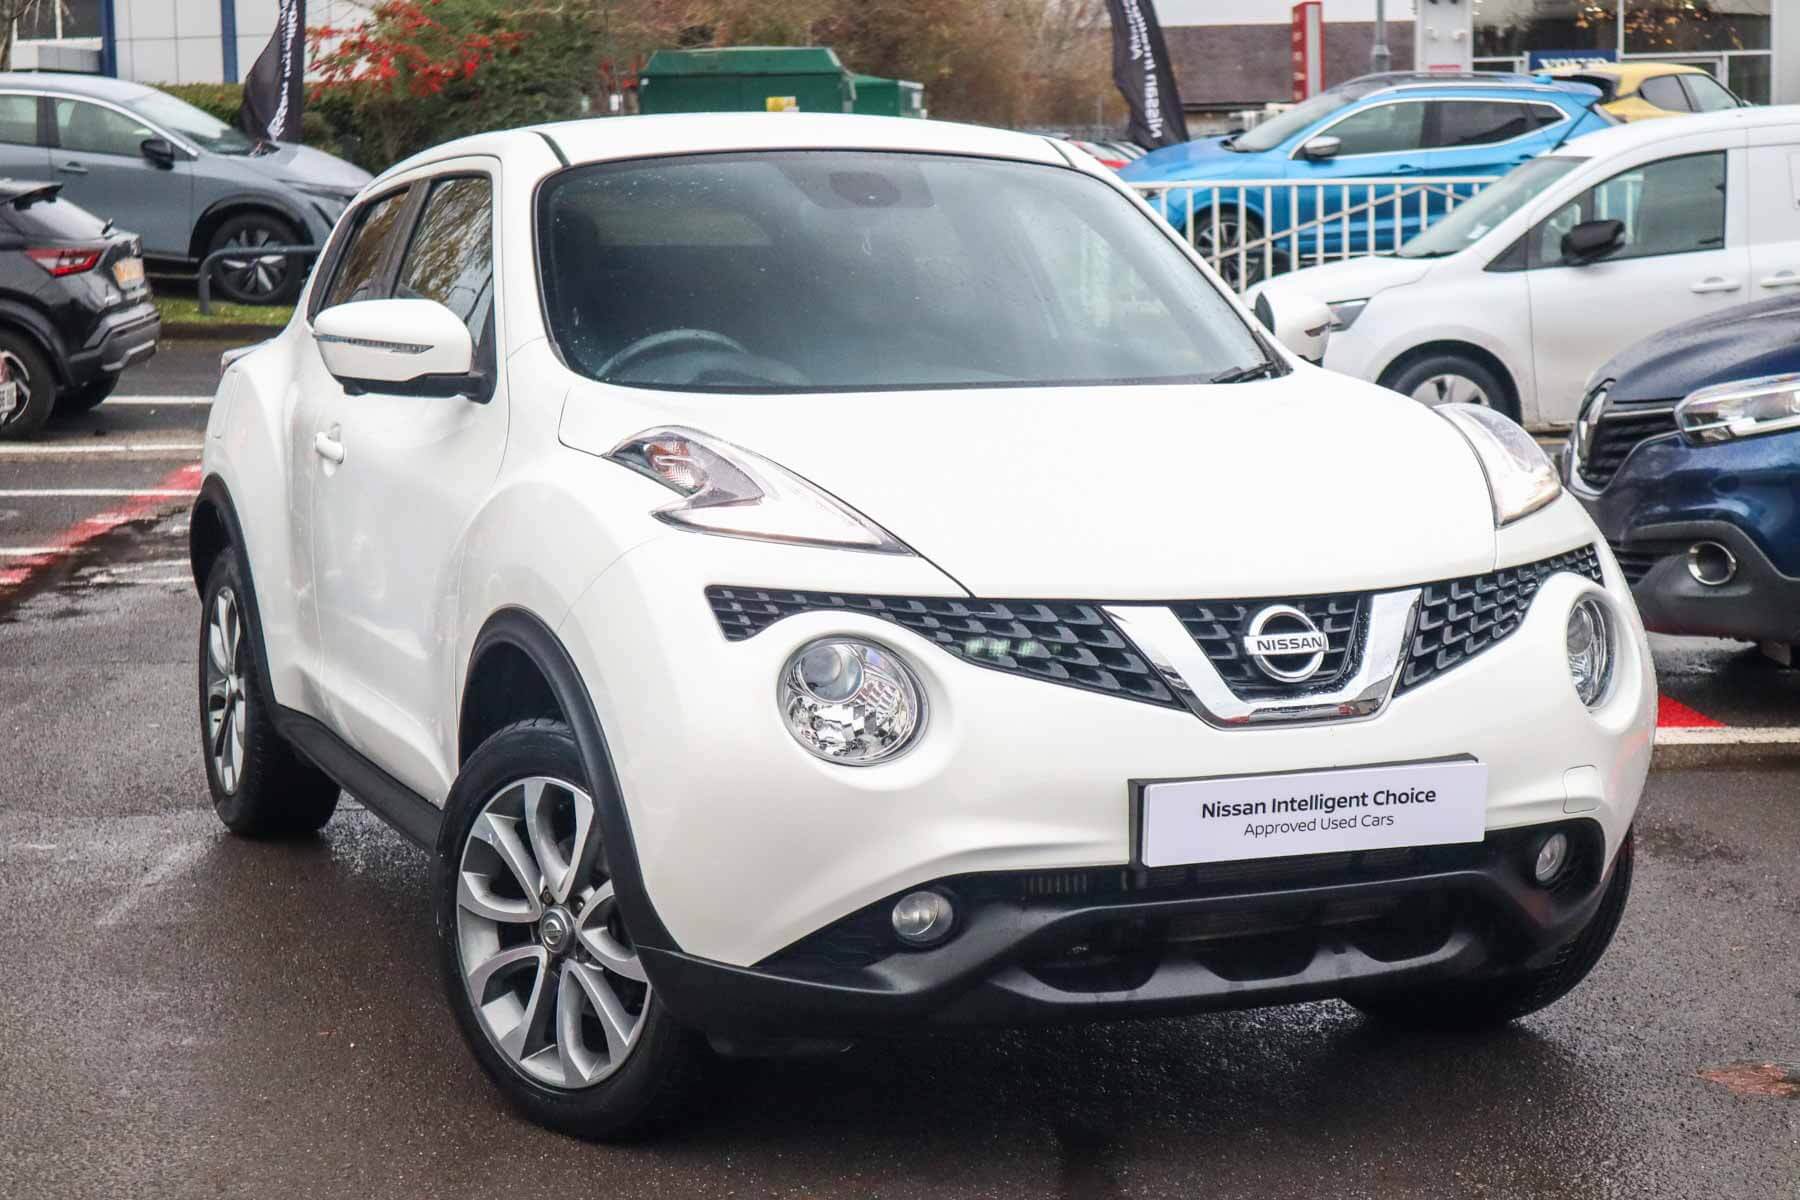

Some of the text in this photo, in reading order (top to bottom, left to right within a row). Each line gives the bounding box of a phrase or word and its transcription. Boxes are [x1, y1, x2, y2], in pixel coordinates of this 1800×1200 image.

[1257, 636, 1323, 651] NISSAN
[1202, 787, 1437, 819] Nissan Intelligent Choice
[1243, 813, 1394, 838] Approved Used Cars
